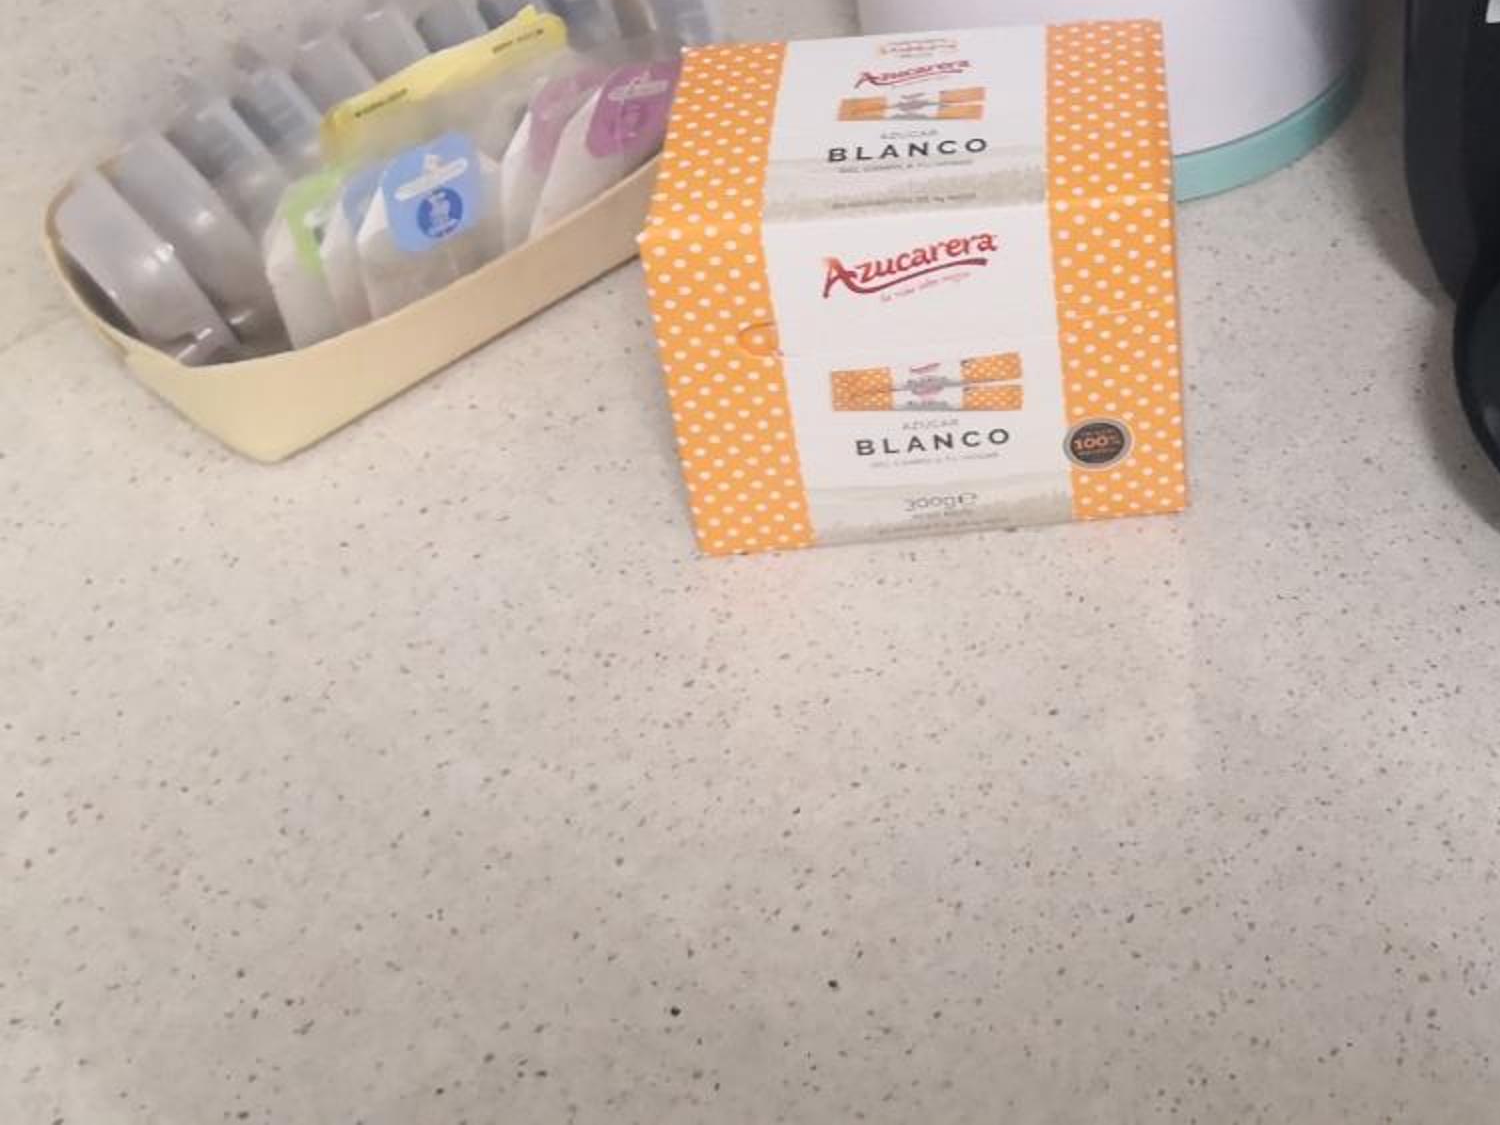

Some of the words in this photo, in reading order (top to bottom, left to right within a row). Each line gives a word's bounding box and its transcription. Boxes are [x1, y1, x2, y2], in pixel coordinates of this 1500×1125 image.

[827, 137, 989, 164] BLANCO
[822, 232, 998, 299] Azucarera
[855, 427, 1010, 457] BLANCO
